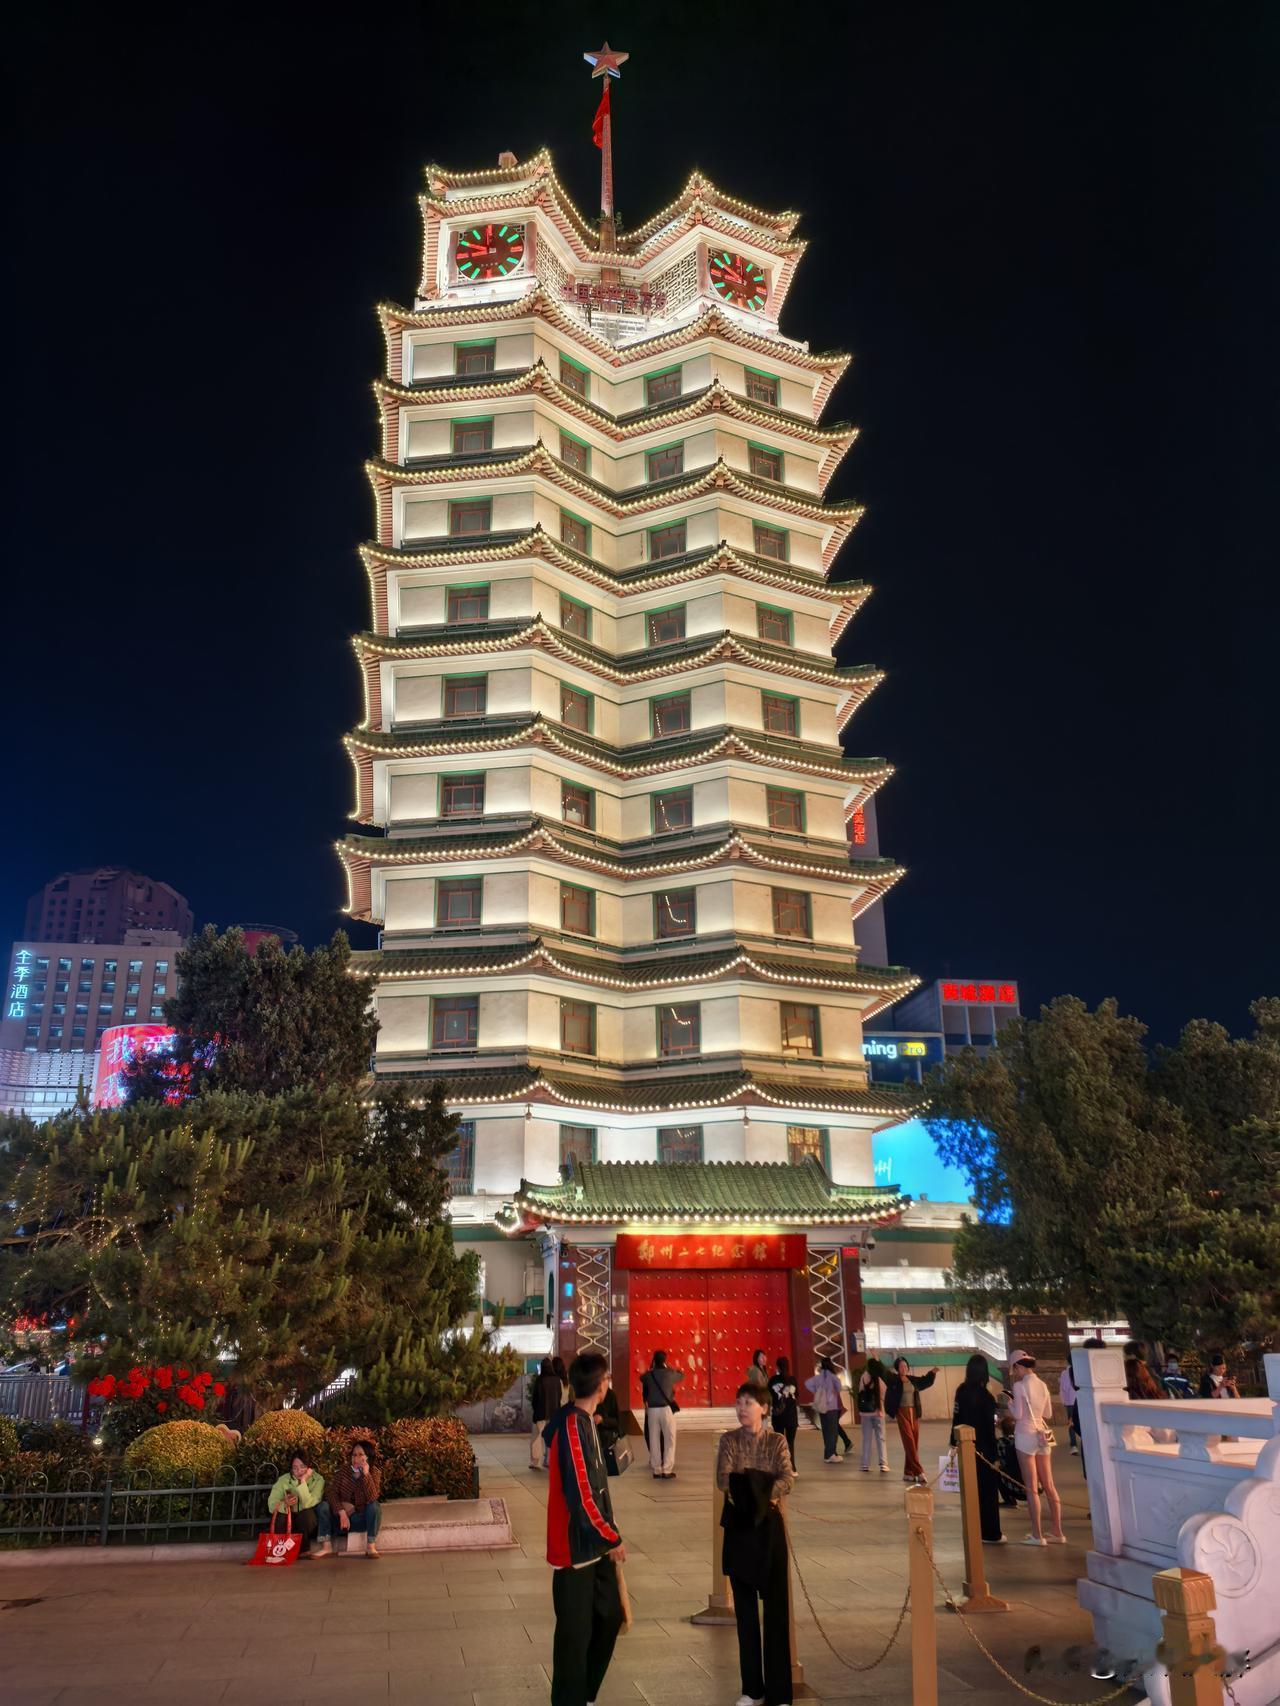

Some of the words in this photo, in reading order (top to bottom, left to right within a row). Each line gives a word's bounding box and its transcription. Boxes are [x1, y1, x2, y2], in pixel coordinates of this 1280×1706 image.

[8, 949, 33, 1017] 全季酒店
[861, 1039, 898, 1059] ning
[900, 1043, 923, 1055] Pro
